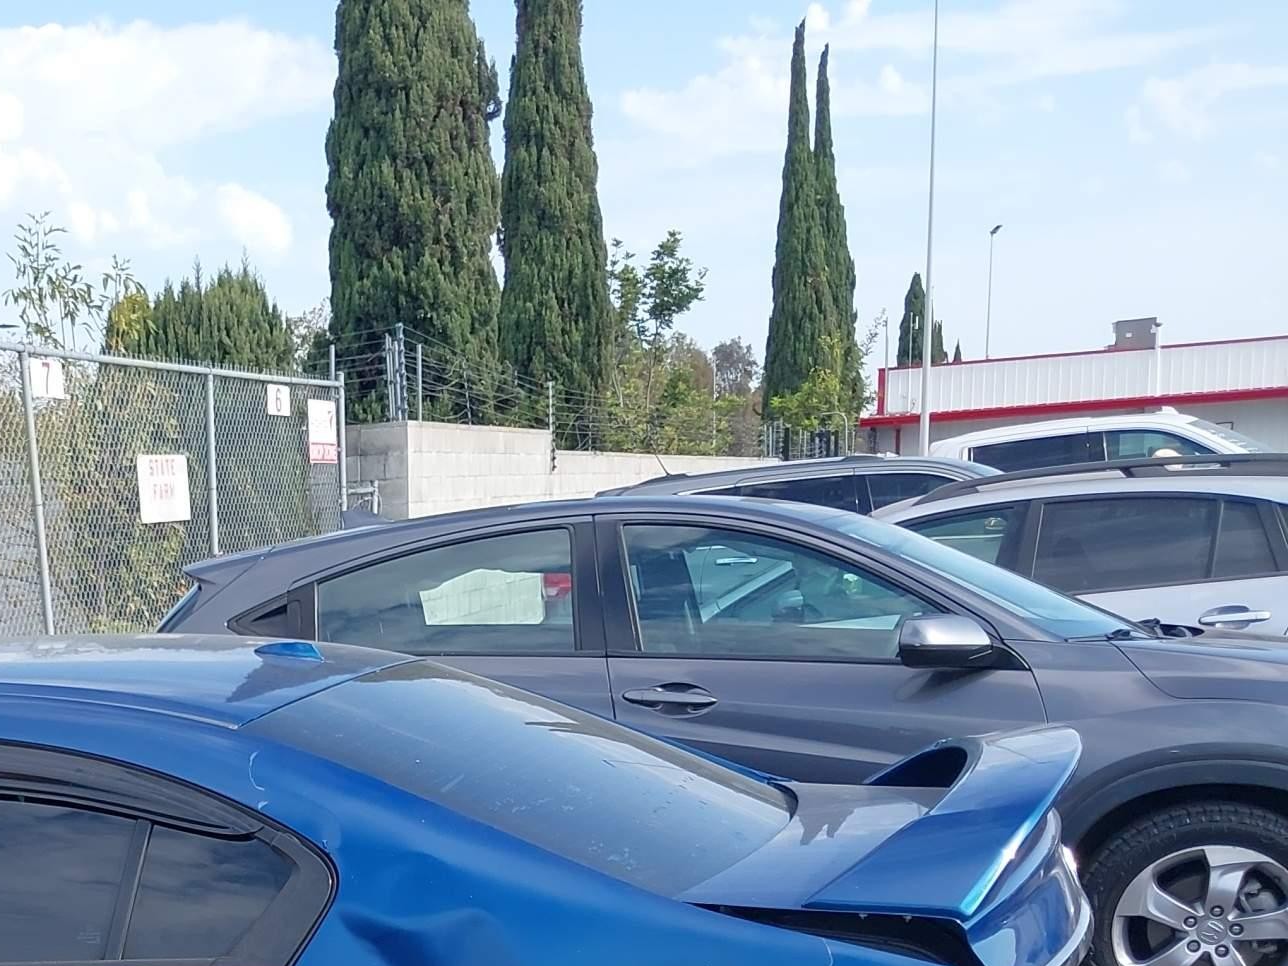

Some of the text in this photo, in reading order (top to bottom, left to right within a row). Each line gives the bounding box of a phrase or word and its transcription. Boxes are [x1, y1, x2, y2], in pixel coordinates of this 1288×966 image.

[42, 362, 50, 395] 7
[275, 388, 282, 412] 6
[149, 459, 176, 476] STATE
[153, 482, 175, 500] FARM
